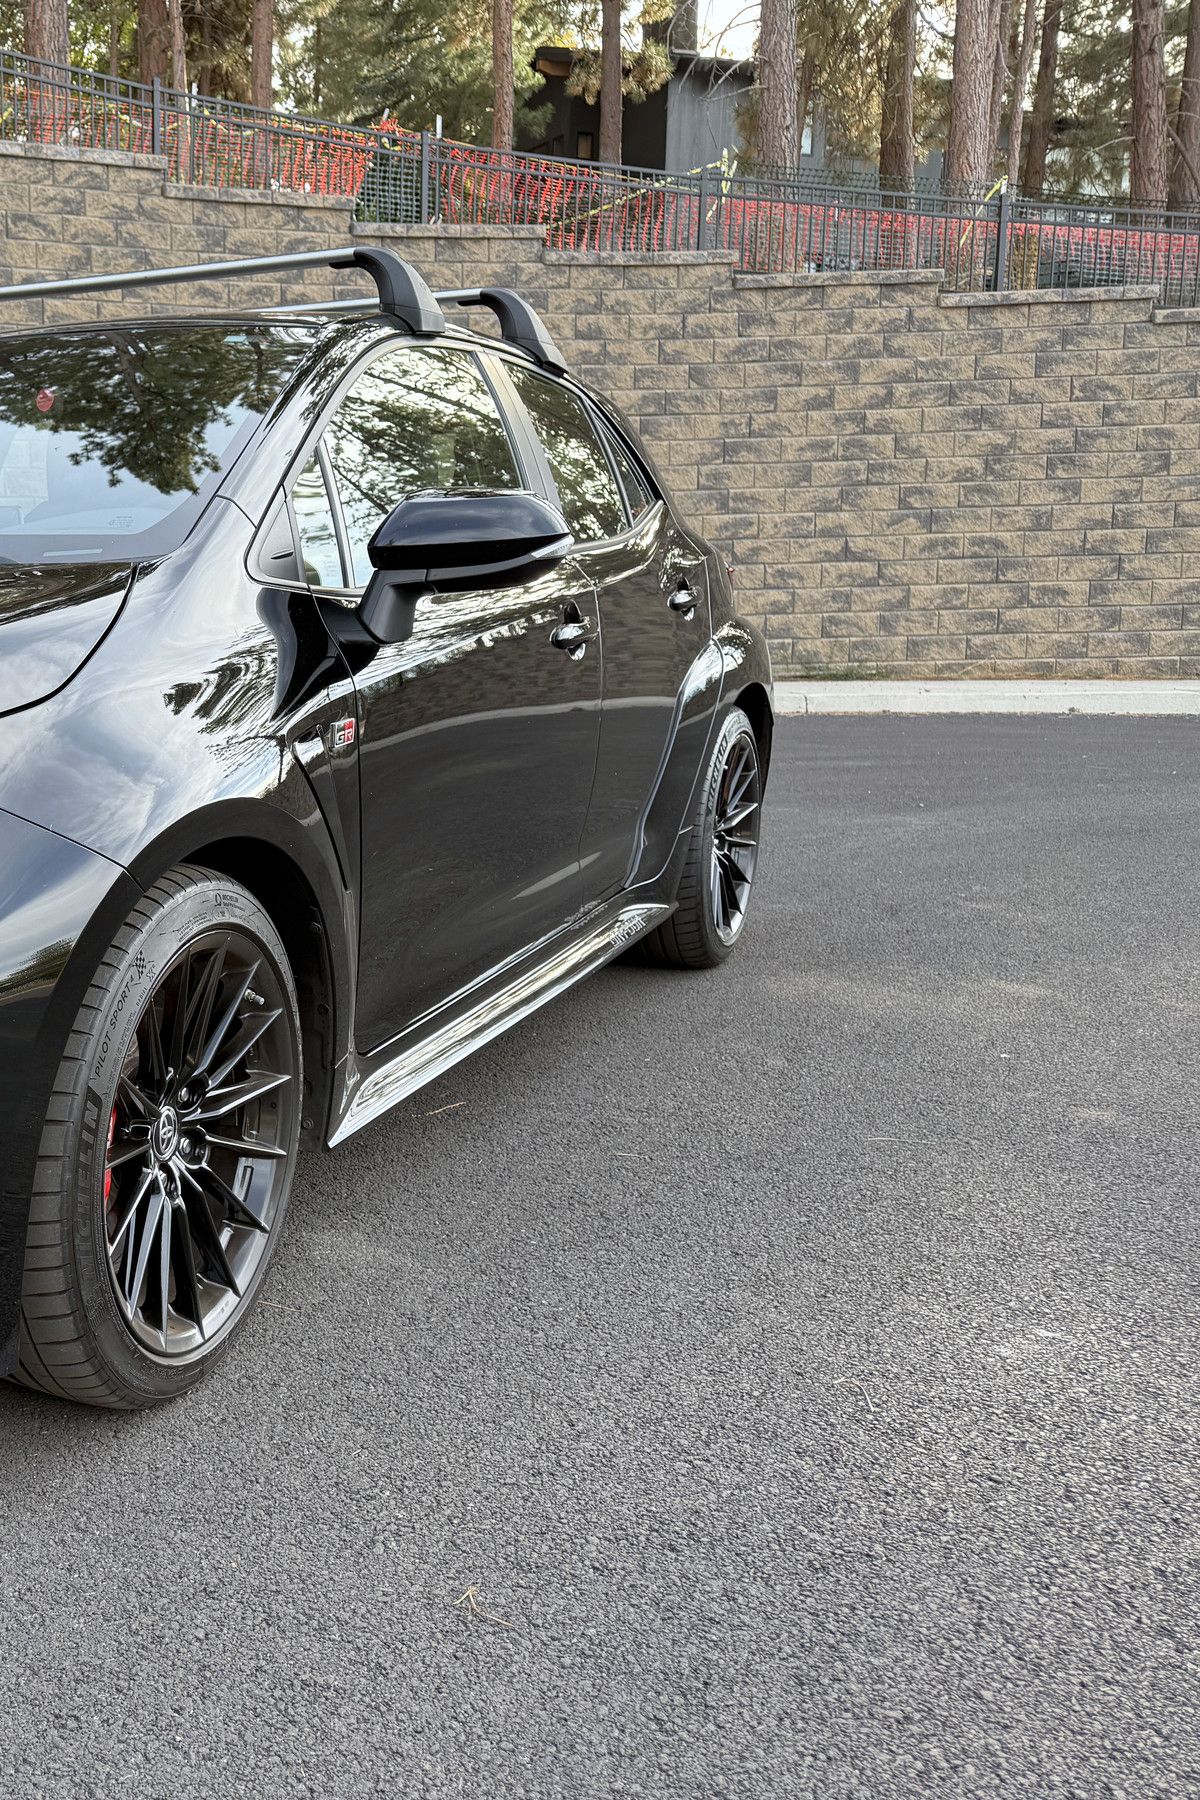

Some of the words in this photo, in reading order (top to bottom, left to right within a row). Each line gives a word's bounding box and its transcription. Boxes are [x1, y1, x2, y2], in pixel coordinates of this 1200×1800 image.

[335, 728, 353, 745] GR
[94, 1031, 111, 1078] PILOT
[109, 981, 131, 1030] SPORT
